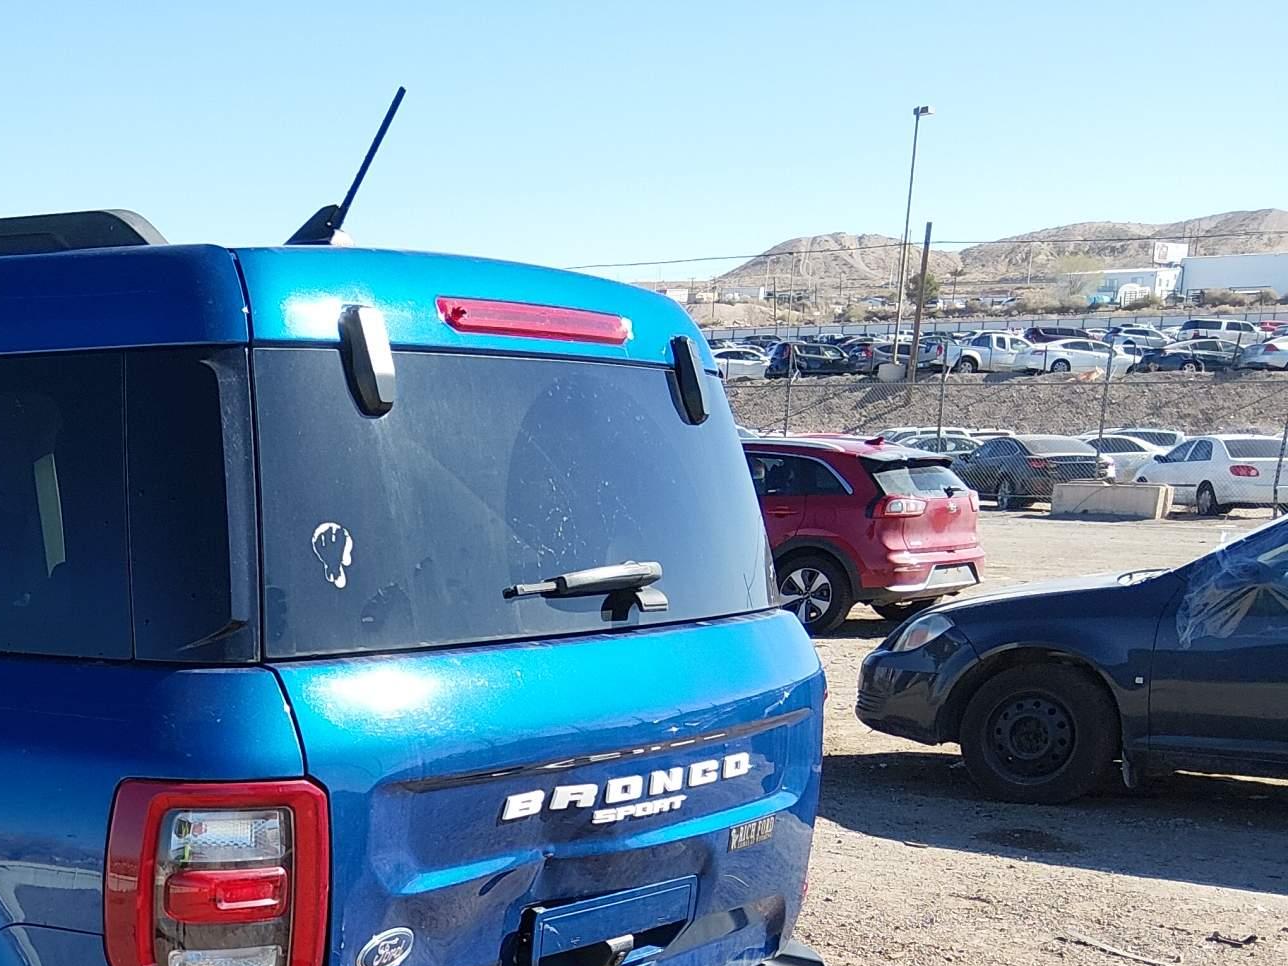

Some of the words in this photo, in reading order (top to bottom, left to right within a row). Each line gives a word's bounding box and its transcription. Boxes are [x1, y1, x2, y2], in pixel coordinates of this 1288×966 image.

[502, 752, 751, 821] BRONCO
[592, 795, 687, 824] SPORT
[738, 822, 757, 842] RICH
[757, 816, 775, 838] FORD
[372, 937, 406, 966] Ford
